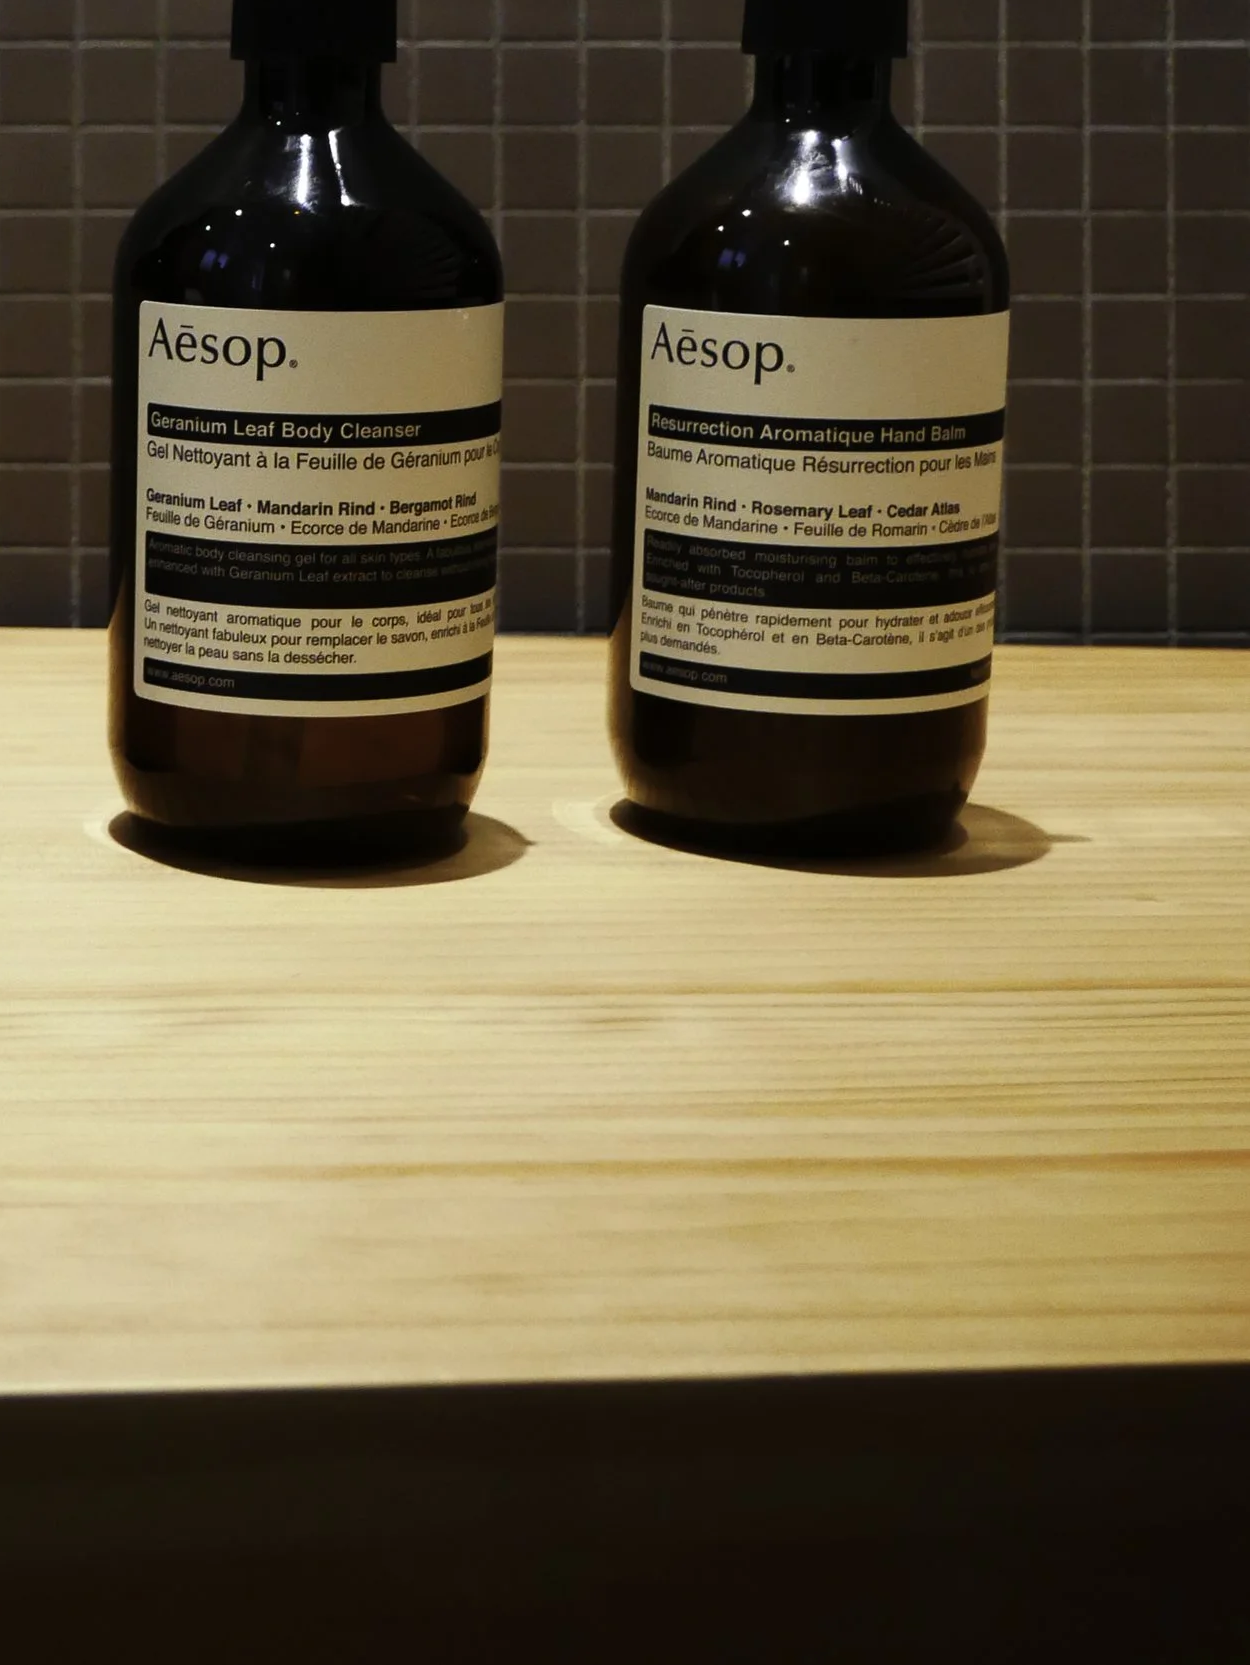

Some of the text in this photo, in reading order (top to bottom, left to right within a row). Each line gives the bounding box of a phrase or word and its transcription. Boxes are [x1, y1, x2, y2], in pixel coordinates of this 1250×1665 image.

[151, 411, 421, 443] Geranium Leaf Body Cleanser
[652, 412, 966, 447] Resurrection Aromatique Hand Balm
[147, 440, 168, 459] Gel
[173, 444, 250, 469] Nettoyant
[257, 452, 267, 468] à
[274, 452, 290, 469] la
[297, 452, 357, 470] Feuille
[363, 453, 385, 469] de
[391, 449, 461, 469] Géranium
[464, 446, 485, 466] pour
[648, 441, 692, 462] Baume
[697, 448, 795, 474] Aromatique
[803, 455, 914, 474] Résurrection
[920, 458, 951, 476] pour
[955, 454, 971, 469] les
[146, 488, 476, 516] Geranium Leaf Mandarin Rind Bergamot Rind
[646, 487, 960, 521] Mandarin Rind Rosemary Leaf Cedar Atlas
[146, 507, 440, 535] Feuille de Géranium Ecorce de Mandarine
[645, 505, 680, 524] Ecorce
[684, 513, 699, 526] de
[703, 515, 778, 534] Mandarine
[794, 522, 843, 536] Feuille
[848, 522, 867, 536] de
[872, 522, 927, 537] Romarin
[150, 538, 386, 567] Aromatic body cleansing gel for skin
[689, 543, 837, 568] absorbed moisturising
[201, 564, 378, 583] with Geranium Leaf extract
[697, 563, 805, 584] with Tocopherol
[144, 599, 160, 614] Gel
[166, 605, 218, 623] nettoyant
[226, 613, 302, 630] aromatique
[311, 617, 342, 631] pour
[351, 615, 363, 627] le
[372, 615, 409, 629] corps,
[416, 609, 441, 624] idéal
[447, 607, 466, 623] pour
[642, 595, 939, 631] Baume qui pénètre rapidement pour hydrater et
[144, 617, 460, 649] Un nettoyant fabuleux pour remplacer le savon, enrichi
[642, 612, 912, 646] Enrichi en Tocophérol et en Beta-Carotène,
[144, 636, 357, 664] nettoyer la peau sans la dessécher.
[660, 635, 721, 655] demandés.
